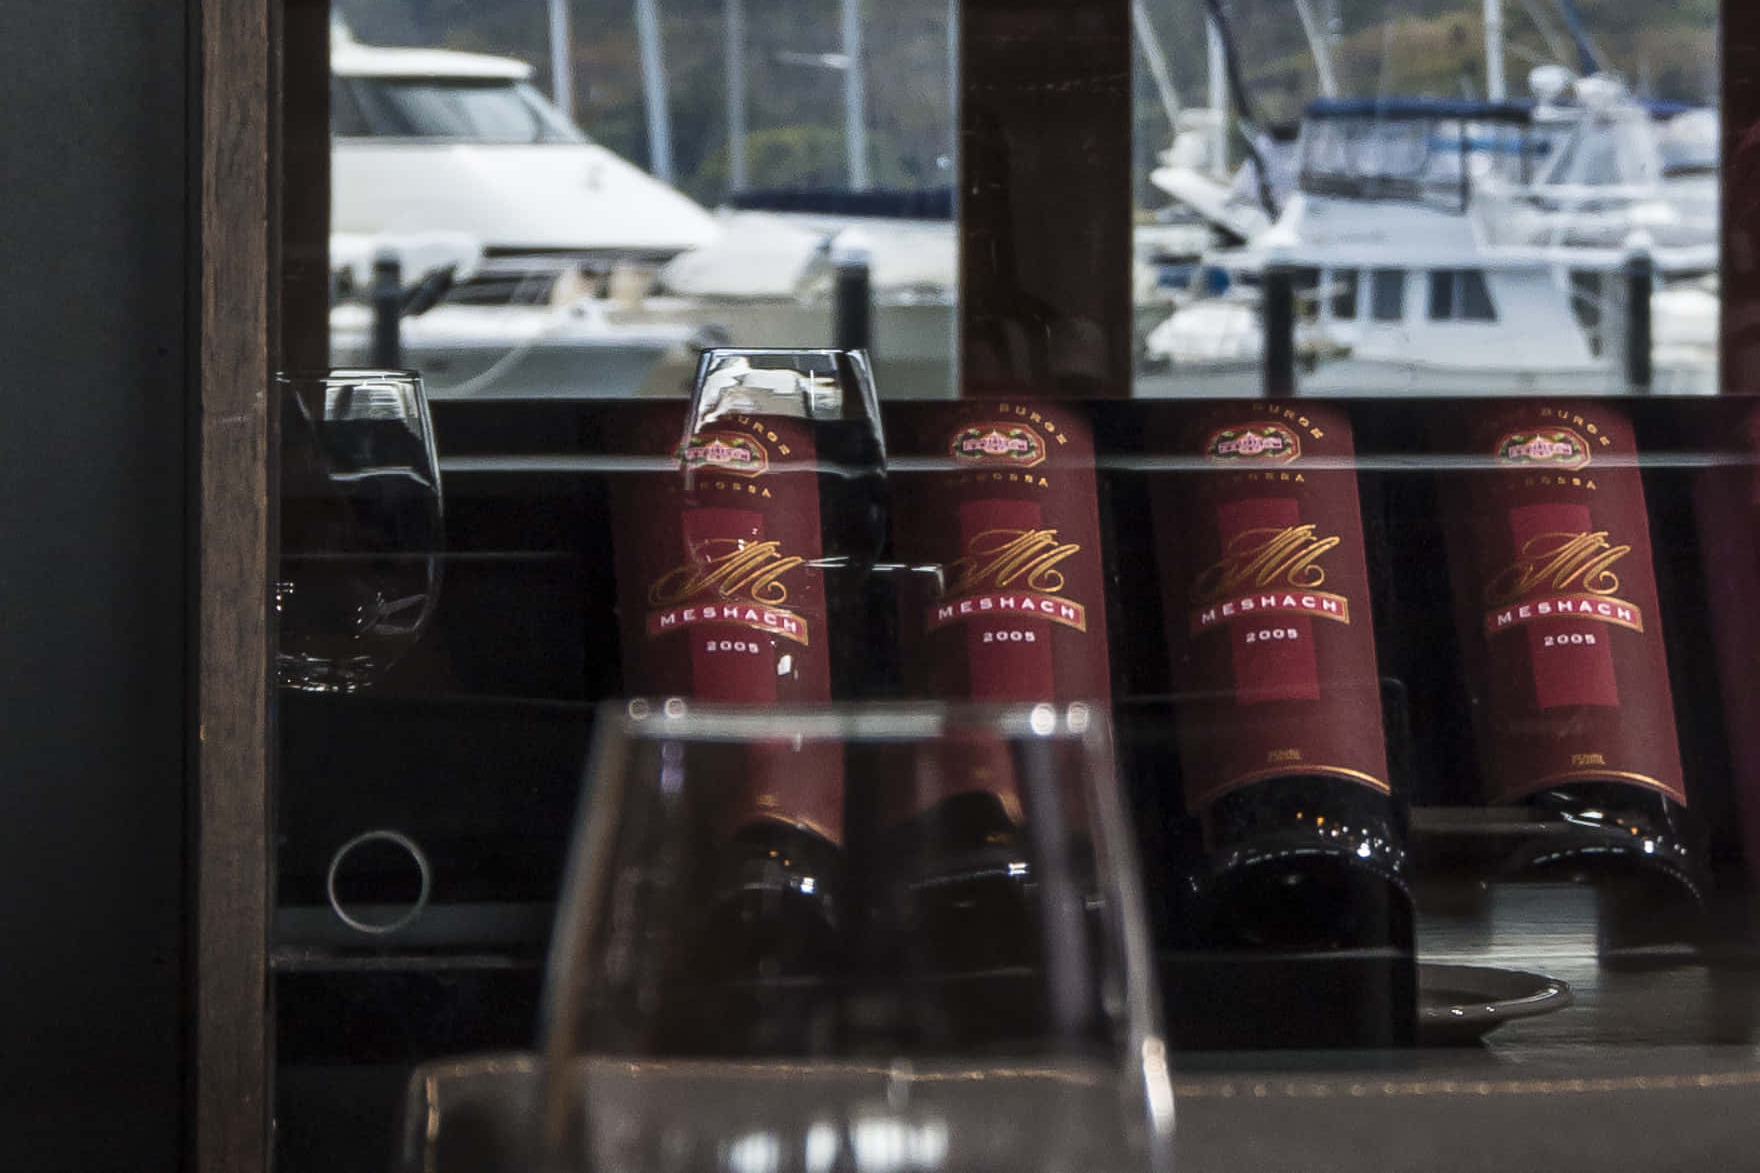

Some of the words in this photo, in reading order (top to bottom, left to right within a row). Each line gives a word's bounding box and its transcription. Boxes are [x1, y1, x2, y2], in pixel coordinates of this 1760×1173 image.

[938, 597, 1075, 621] MESHACH
[1202, 594, 1338, 625] MESHACH
[1497, 599, 1632, 626] MESHACH
[660, 605, 797, 635] MESHACH
[983, 631, 1036, 642] 2005
[1245, 629, 1298, 642] 2005
[1543, 633, 1597, 646] 2005
[706, 641, 759, 653] 2005
